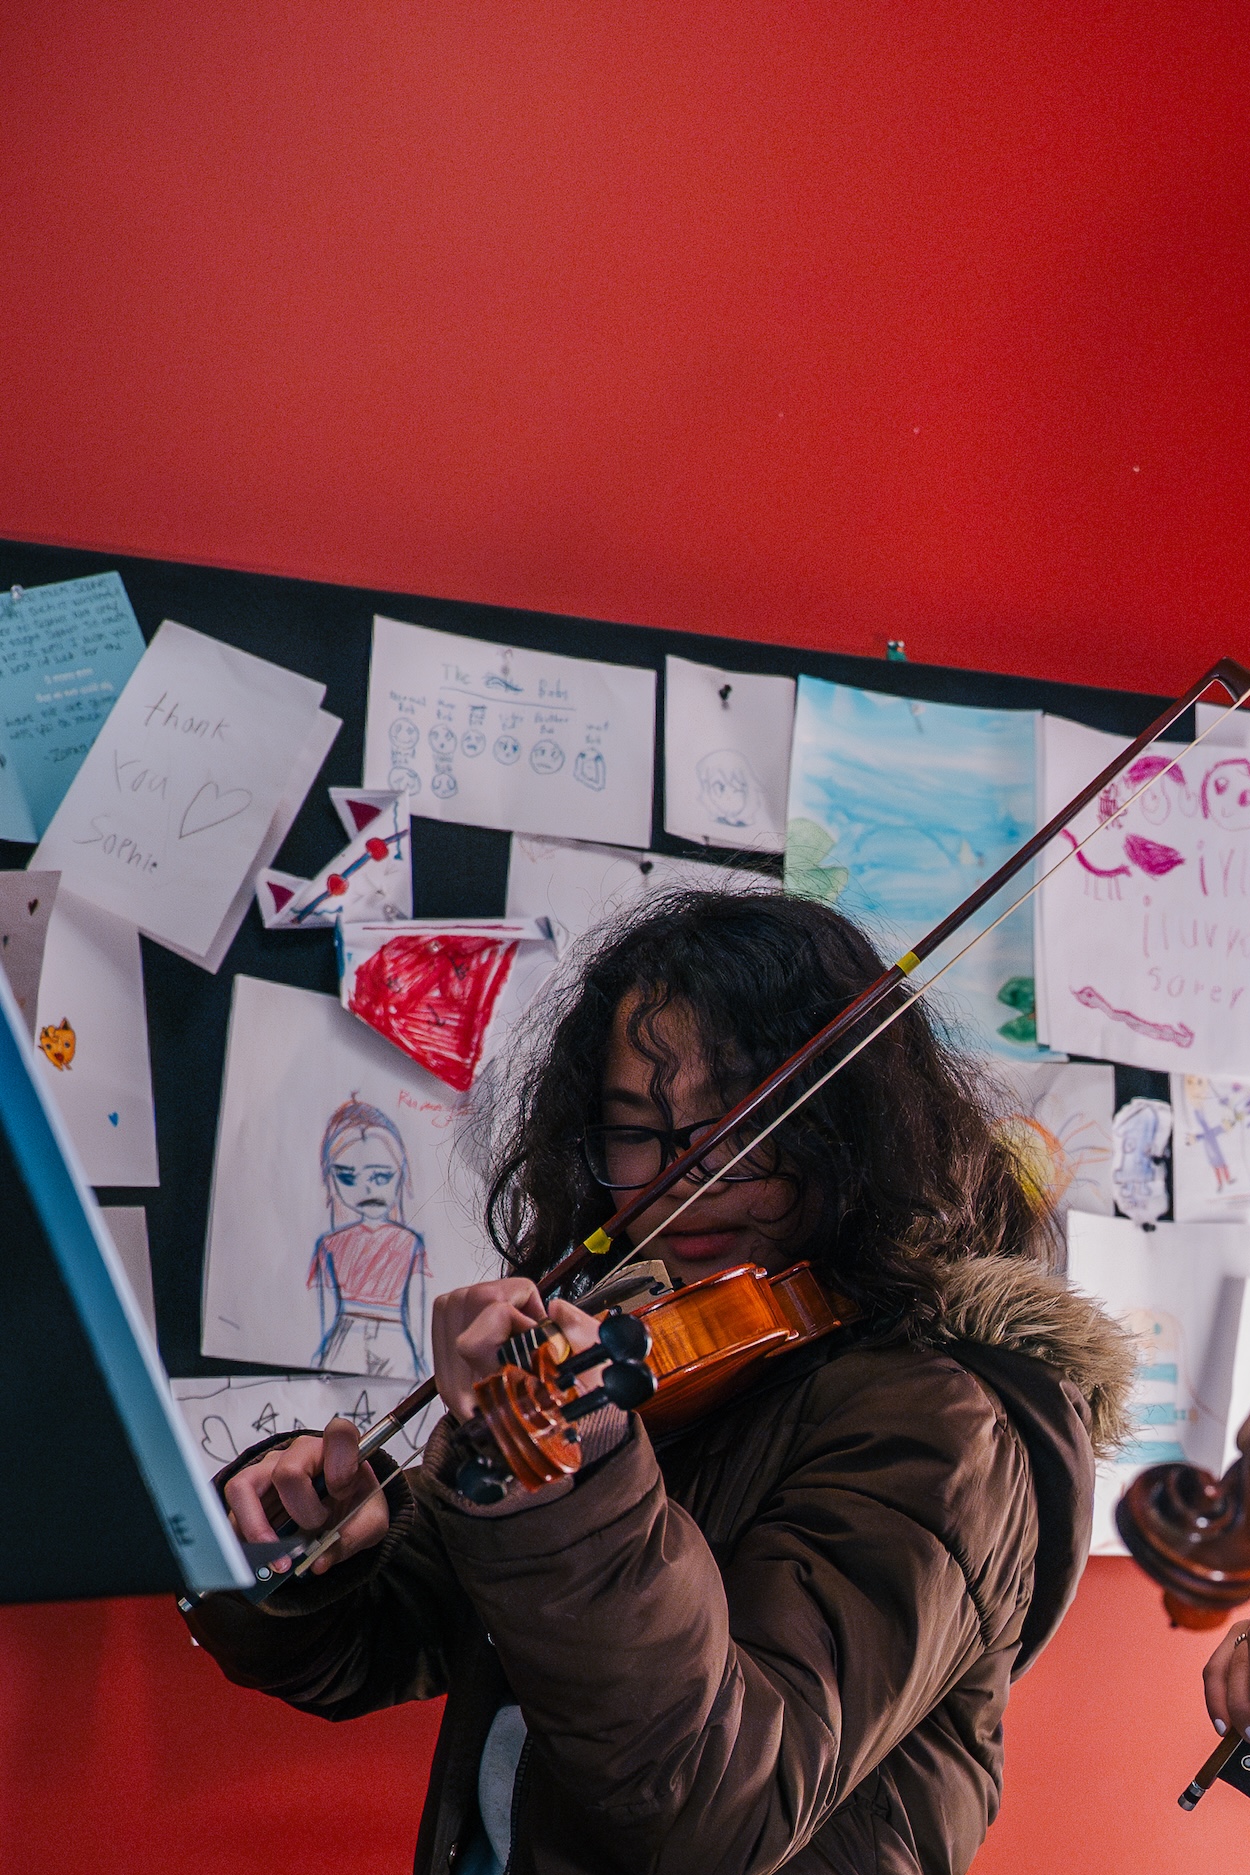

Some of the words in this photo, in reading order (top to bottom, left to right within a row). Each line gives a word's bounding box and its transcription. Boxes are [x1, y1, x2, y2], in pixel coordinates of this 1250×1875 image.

[144, 692, 231, 740] thank
[113, 749, 169, 800] You
[73, 815, 158, 873] Sophie
